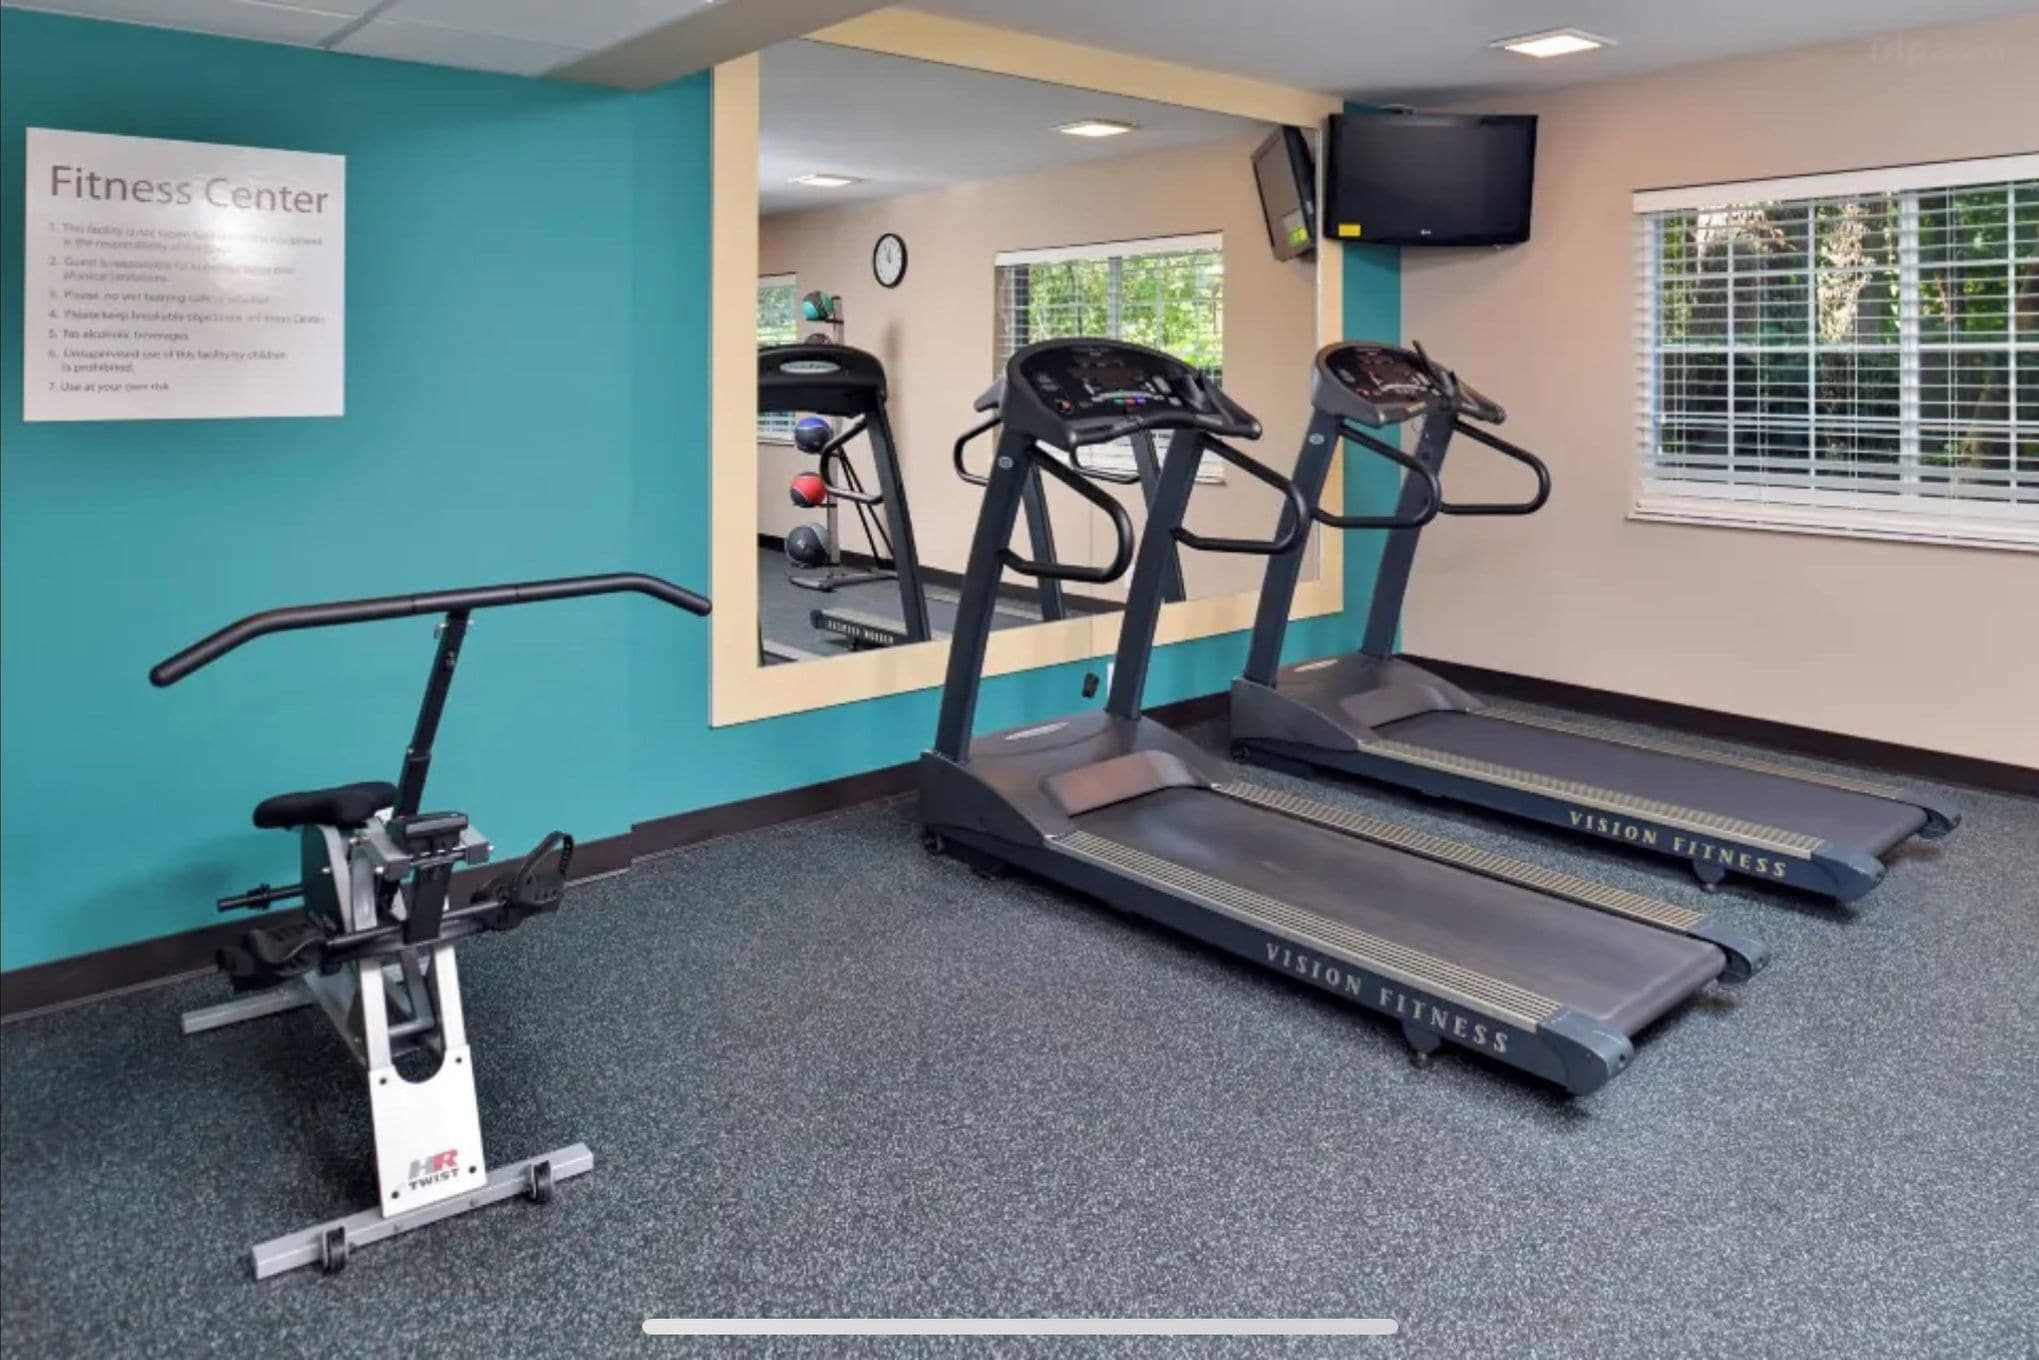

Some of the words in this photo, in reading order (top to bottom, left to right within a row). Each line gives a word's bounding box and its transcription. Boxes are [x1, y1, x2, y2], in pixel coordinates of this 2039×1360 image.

[50, 163, 194, 207] Fitness
[204, 175, 329, 215] Center
[1569, 810, 1658, 845] VISION
[1672, 836, 1788, 878] FITNESS
[1265, 942, 1364, 996] VISION
[1378, 987, 1509, 1054] FITNESS
[408, 1167, 460, 1191] TWIST
